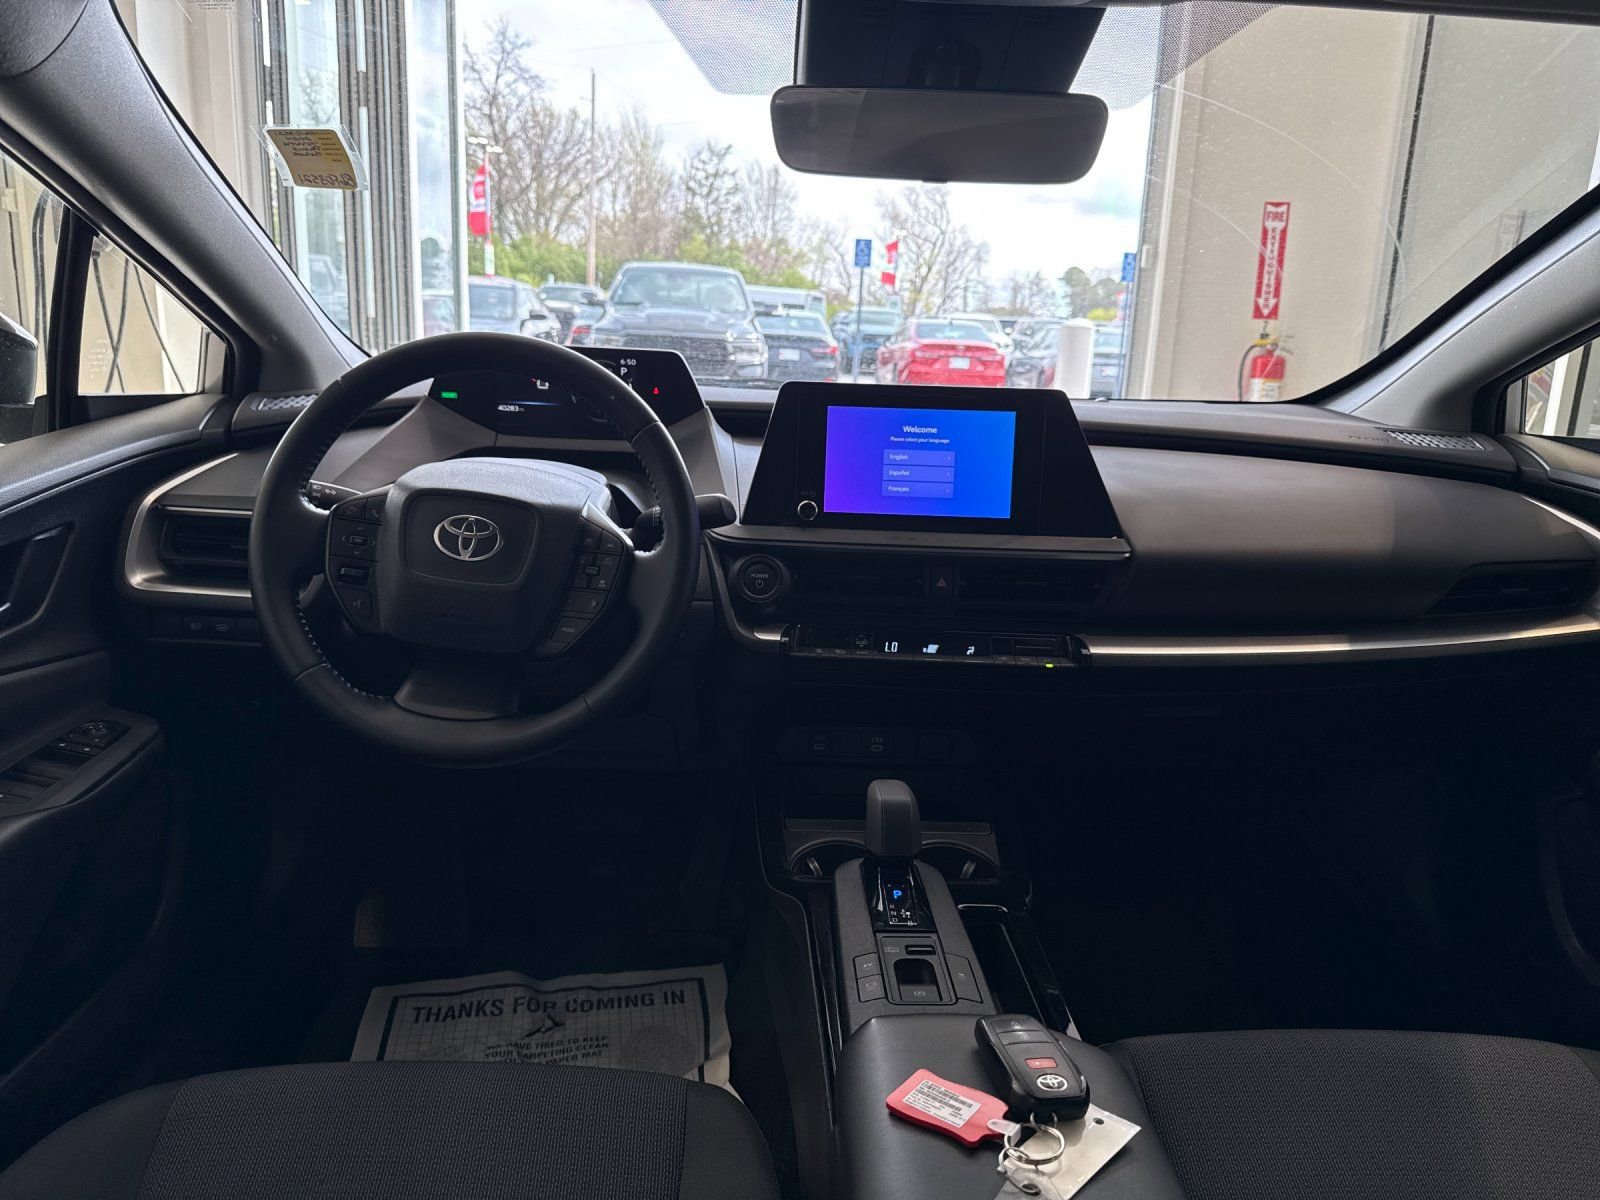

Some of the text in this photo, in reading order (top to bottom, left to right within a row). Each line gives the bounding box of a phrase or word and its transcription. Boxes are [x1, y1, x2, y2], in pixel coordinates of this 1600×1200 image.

[1265, 211, 1285, 222] FIRE
[620, 358, 637, 366] 6:50
[620, 366, 628, 376] P
[497, 404, 519, 413] 40283
[902, 425, 938, 434] Welcome
[928, 437, 950, 445] language
[889, 453, 909, 461] English
[888, 469, 910, 477] Español
[888, 485, 910, 493] Français
[892, 889, 902, 899] P
[412, 988, 686, 1024] THANKS FOR COMING IN
[582, 1035, 609, 1044] KEEP
[485, 1049, 514, 1060] YOUR
[575, 1042, 609, 1052] CLEAN
[582, 1050, 604, 1059] MAT
